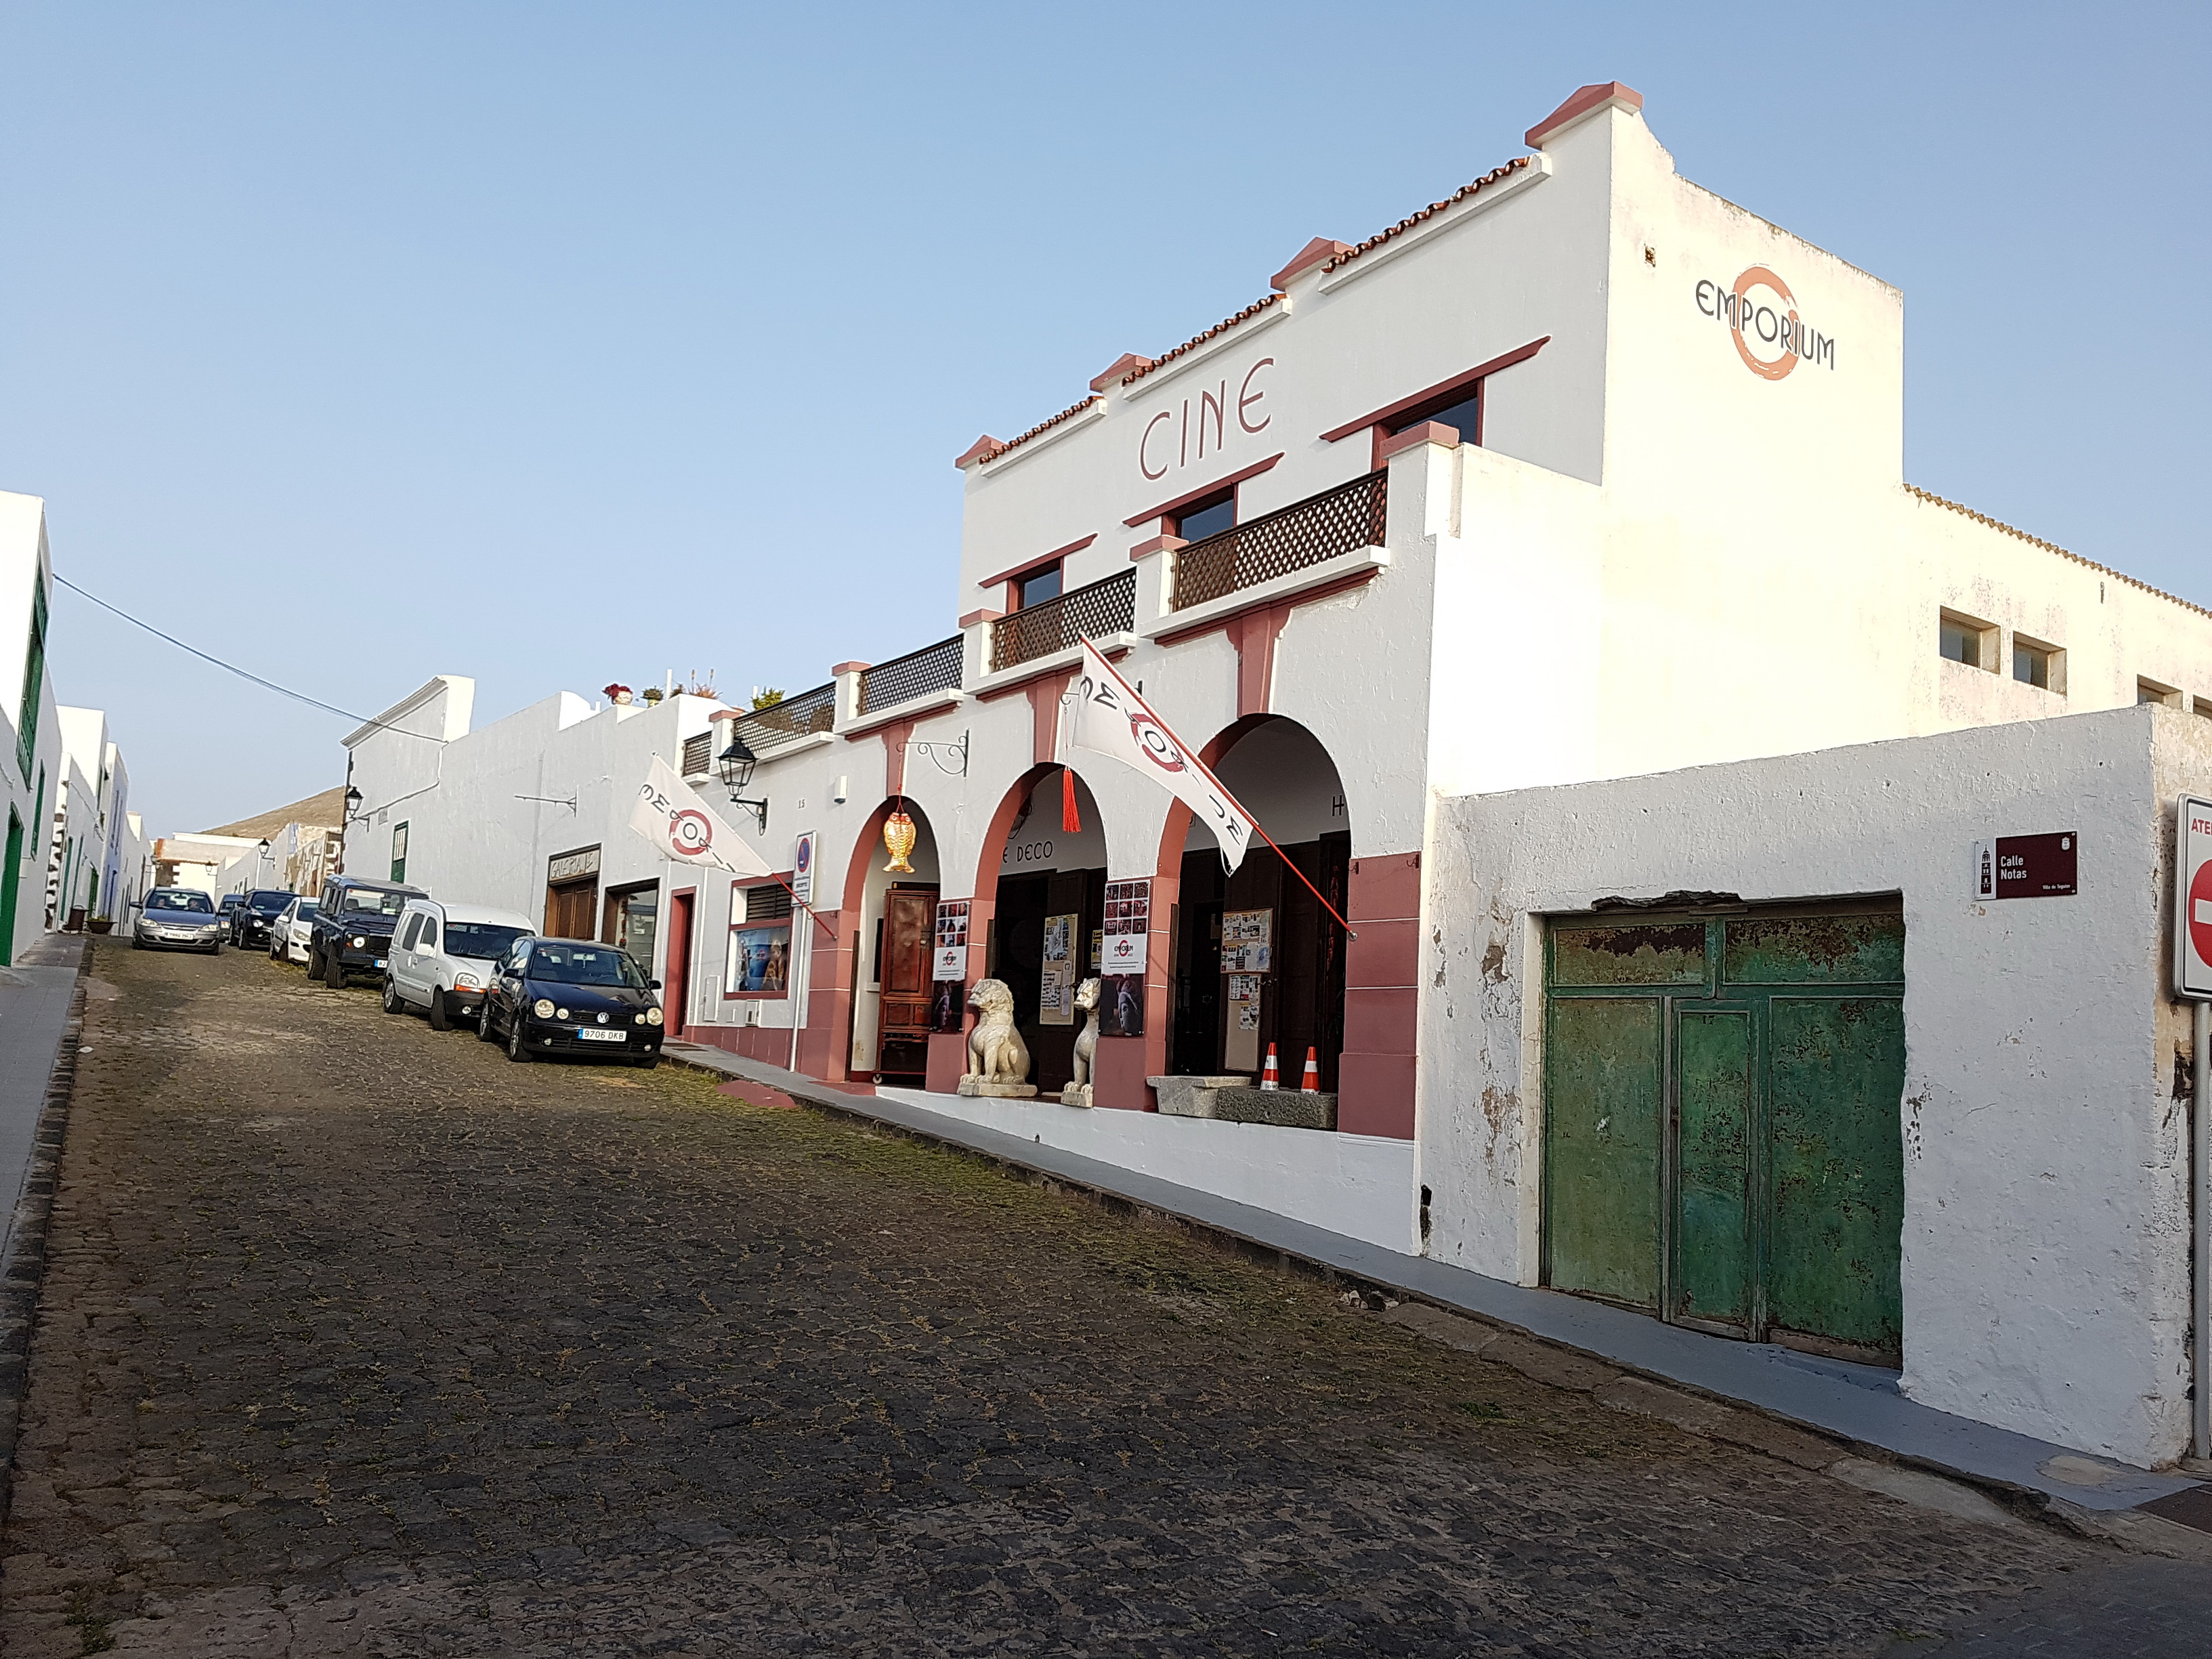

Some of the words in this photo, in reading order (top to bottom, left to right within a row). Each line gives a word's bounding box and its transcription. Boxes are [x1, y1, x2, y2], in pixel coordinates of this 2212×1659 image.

[1695, 278, 1835, 372] EMPORIUM
[1140, 358, 1275, 481] CINE
[2191, 818, 2212, 836] ATE
[1017, 840, 1053, 862] DECO
[2000, 854, 2024, 867] Calle
[2000, 868, 2027, 880] Notas
[584, 1030, 606, 1039] 9706
[608, 1032, 624, 1041] DKB
